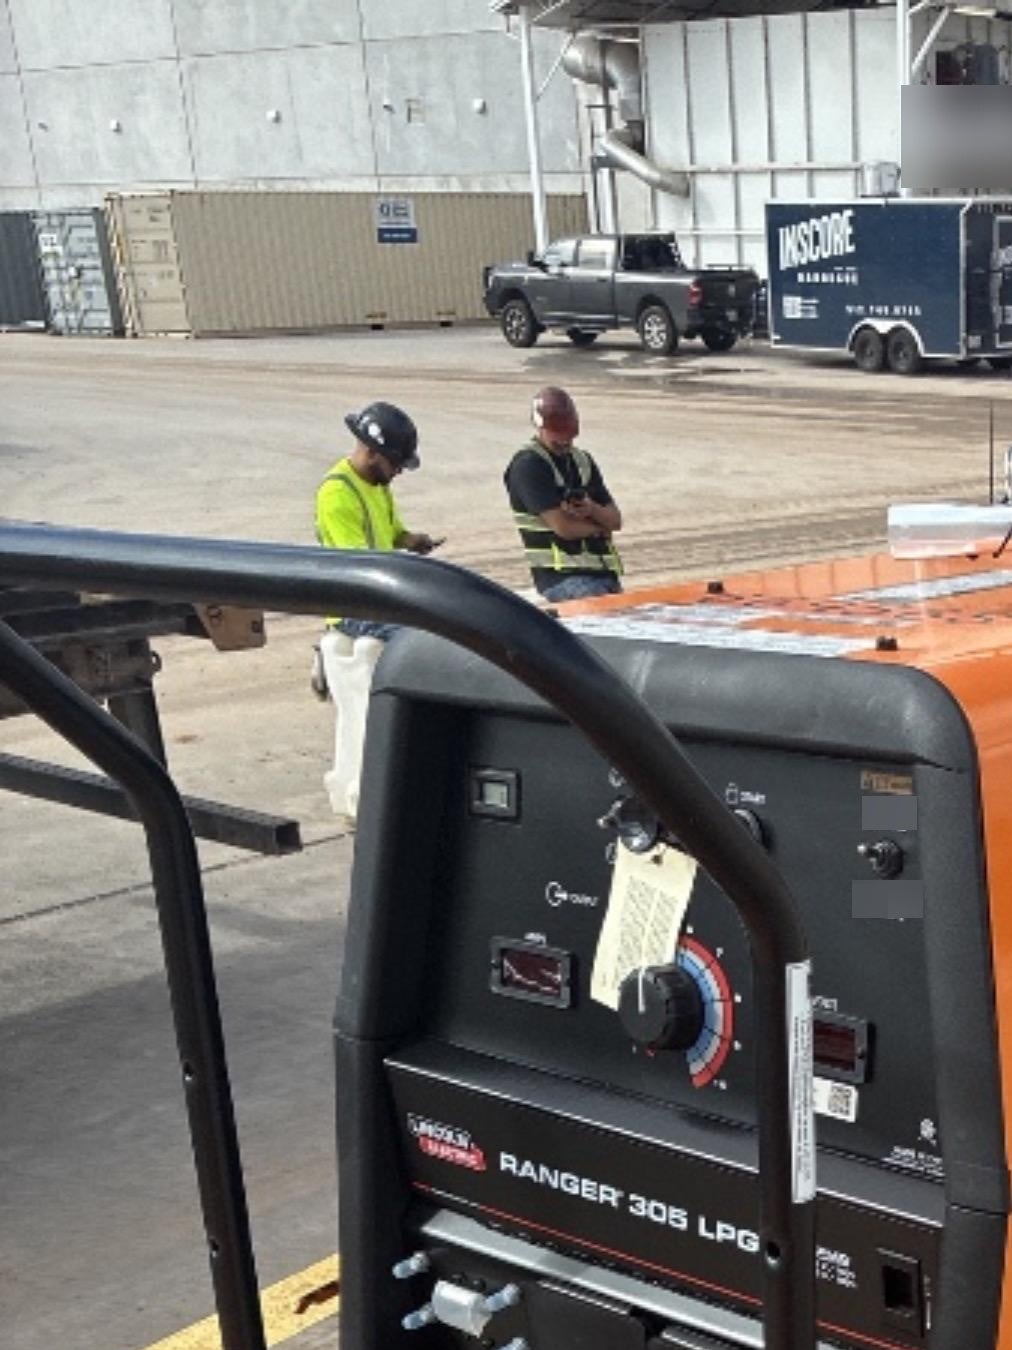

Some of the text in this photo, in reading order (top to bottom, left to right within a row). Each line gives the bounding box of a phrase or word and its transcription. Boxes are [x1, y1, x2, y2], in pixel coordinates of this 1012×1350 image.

[779, 208, 856, 271] INSCORE
[500, 1152, 760, 1252] RANGER 305 LPG
